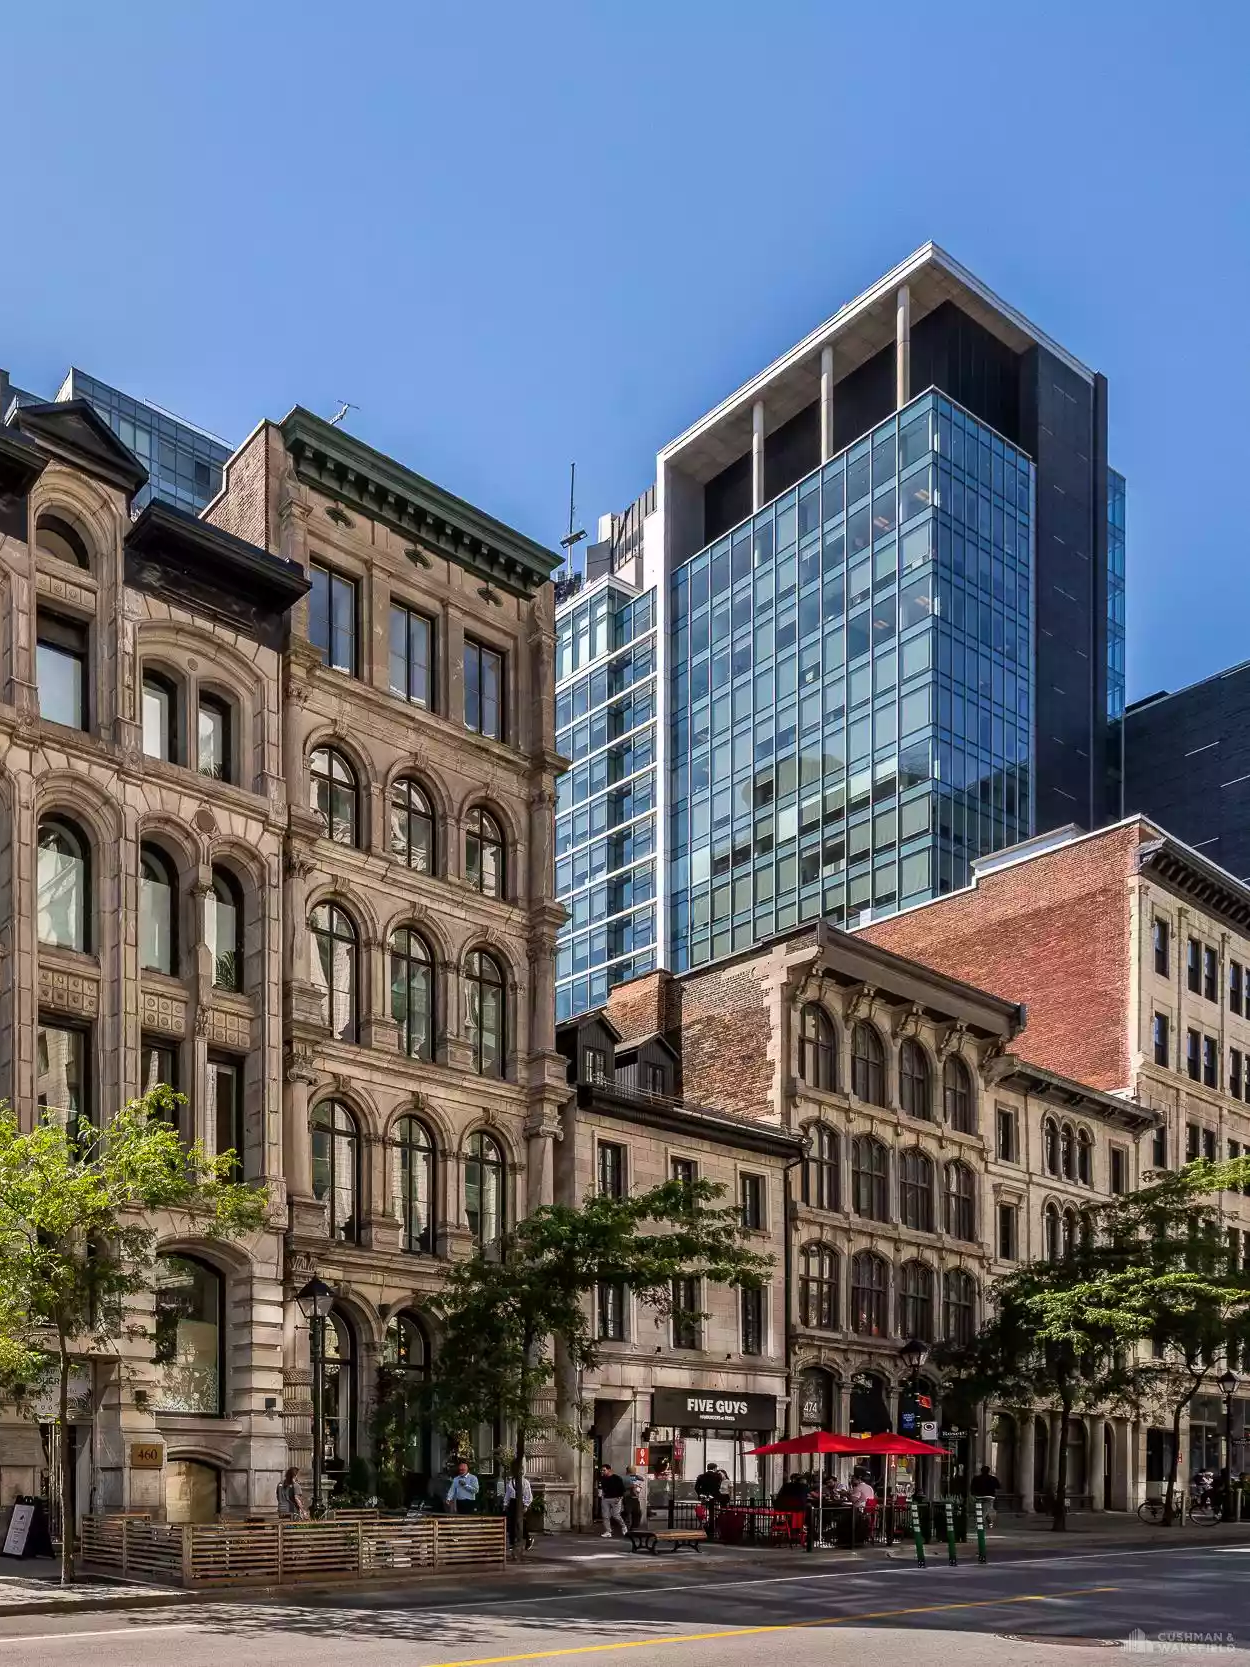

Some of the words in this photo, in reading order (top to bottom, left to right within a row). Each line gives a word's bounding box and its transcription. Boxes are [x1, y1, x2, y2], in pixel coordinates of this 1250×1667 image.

[687, 1398, 714, 1412] FIVE
[715, 1400, 748, 1415] GUYS
[803, 1401, 817, 1413] 474
[138, 1448, 158, 1460] 460
